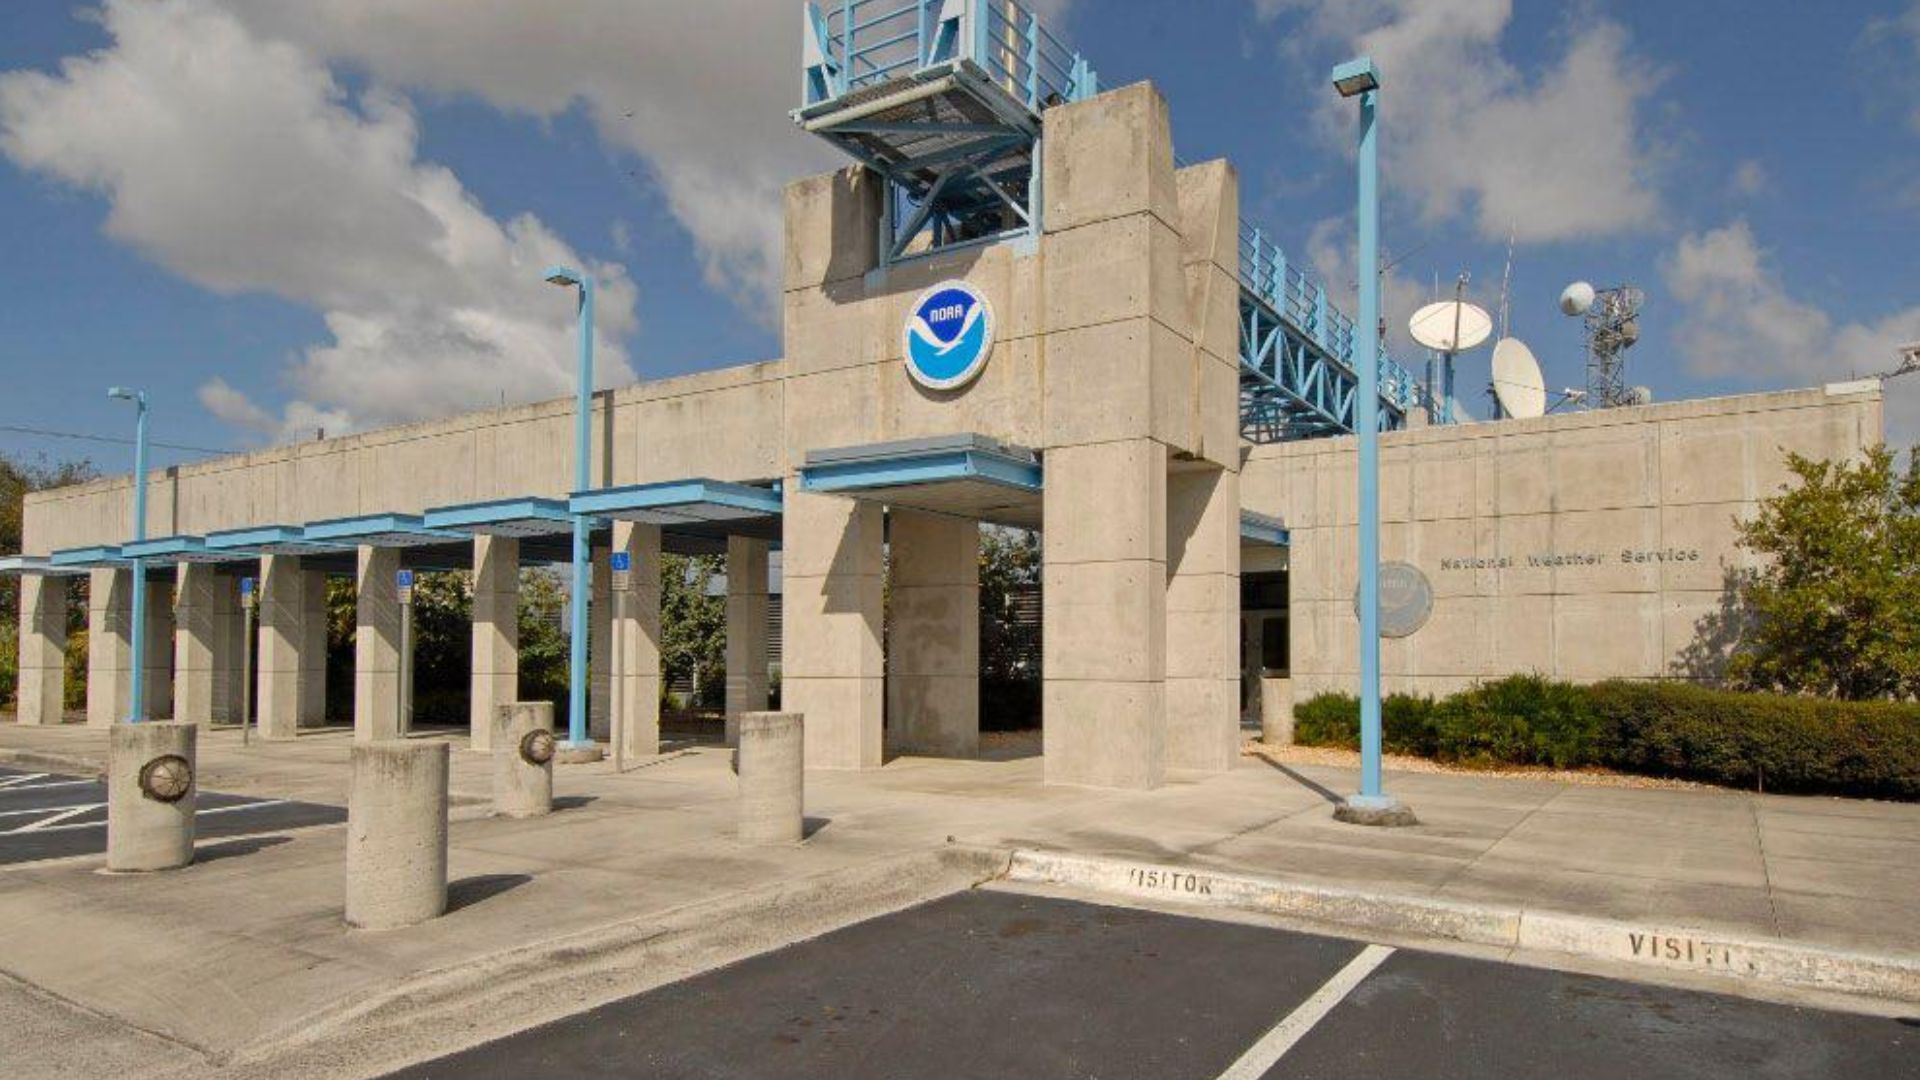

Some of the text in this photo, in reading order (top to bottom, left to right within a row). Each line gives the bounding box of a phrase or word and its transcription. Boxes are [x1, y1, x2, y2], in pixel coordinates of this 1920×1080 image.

[930, 304, 963, 323] NOAA
[1440, 548, 1699, 571] National Weather Service
